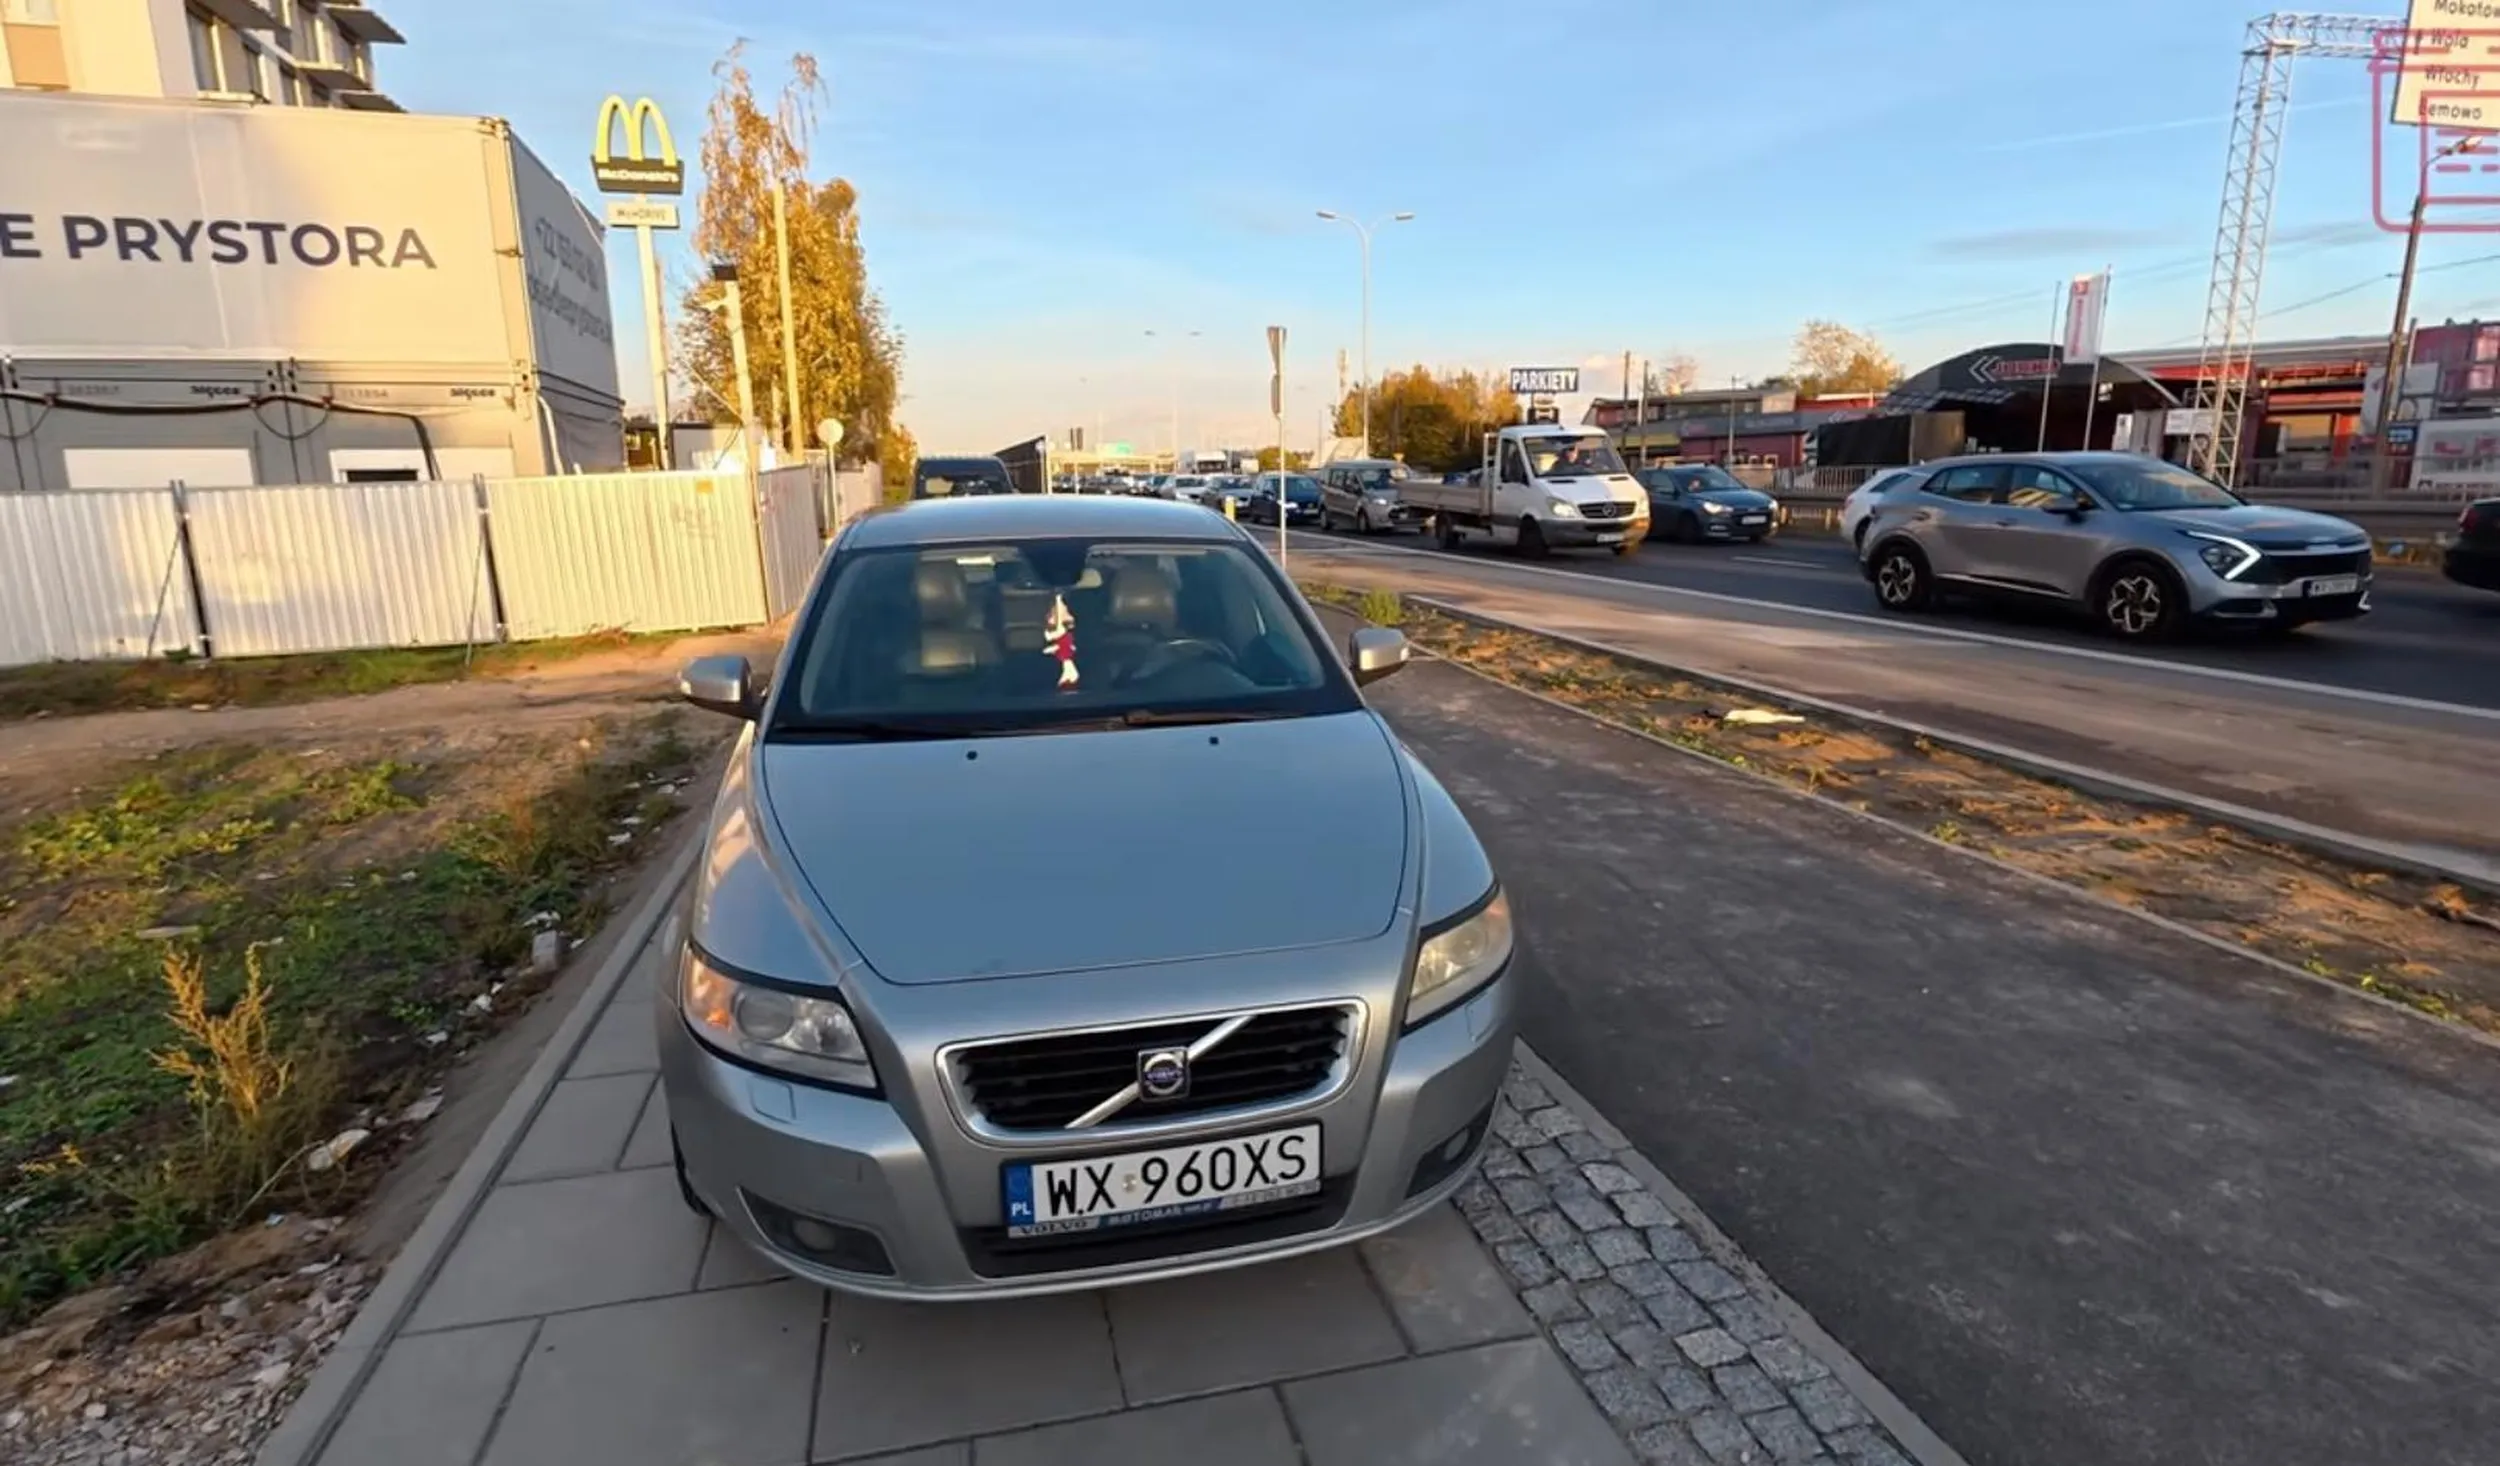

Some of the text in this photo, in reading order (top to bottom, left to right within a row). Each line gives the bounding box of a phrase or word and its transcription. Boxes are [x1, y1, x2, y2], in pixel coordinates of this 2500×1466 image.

[2431, 29, 2469, 49] Wola
[62, 215, 438, 269] PRYSTORA
[1511, 370, 1577, 391] PARKIETY
[1046, 1162, 1116, 1217] WX
[1141, 1135, 1306, 1204] 960XS
[1011, 1202, 1032, 1217] PL
